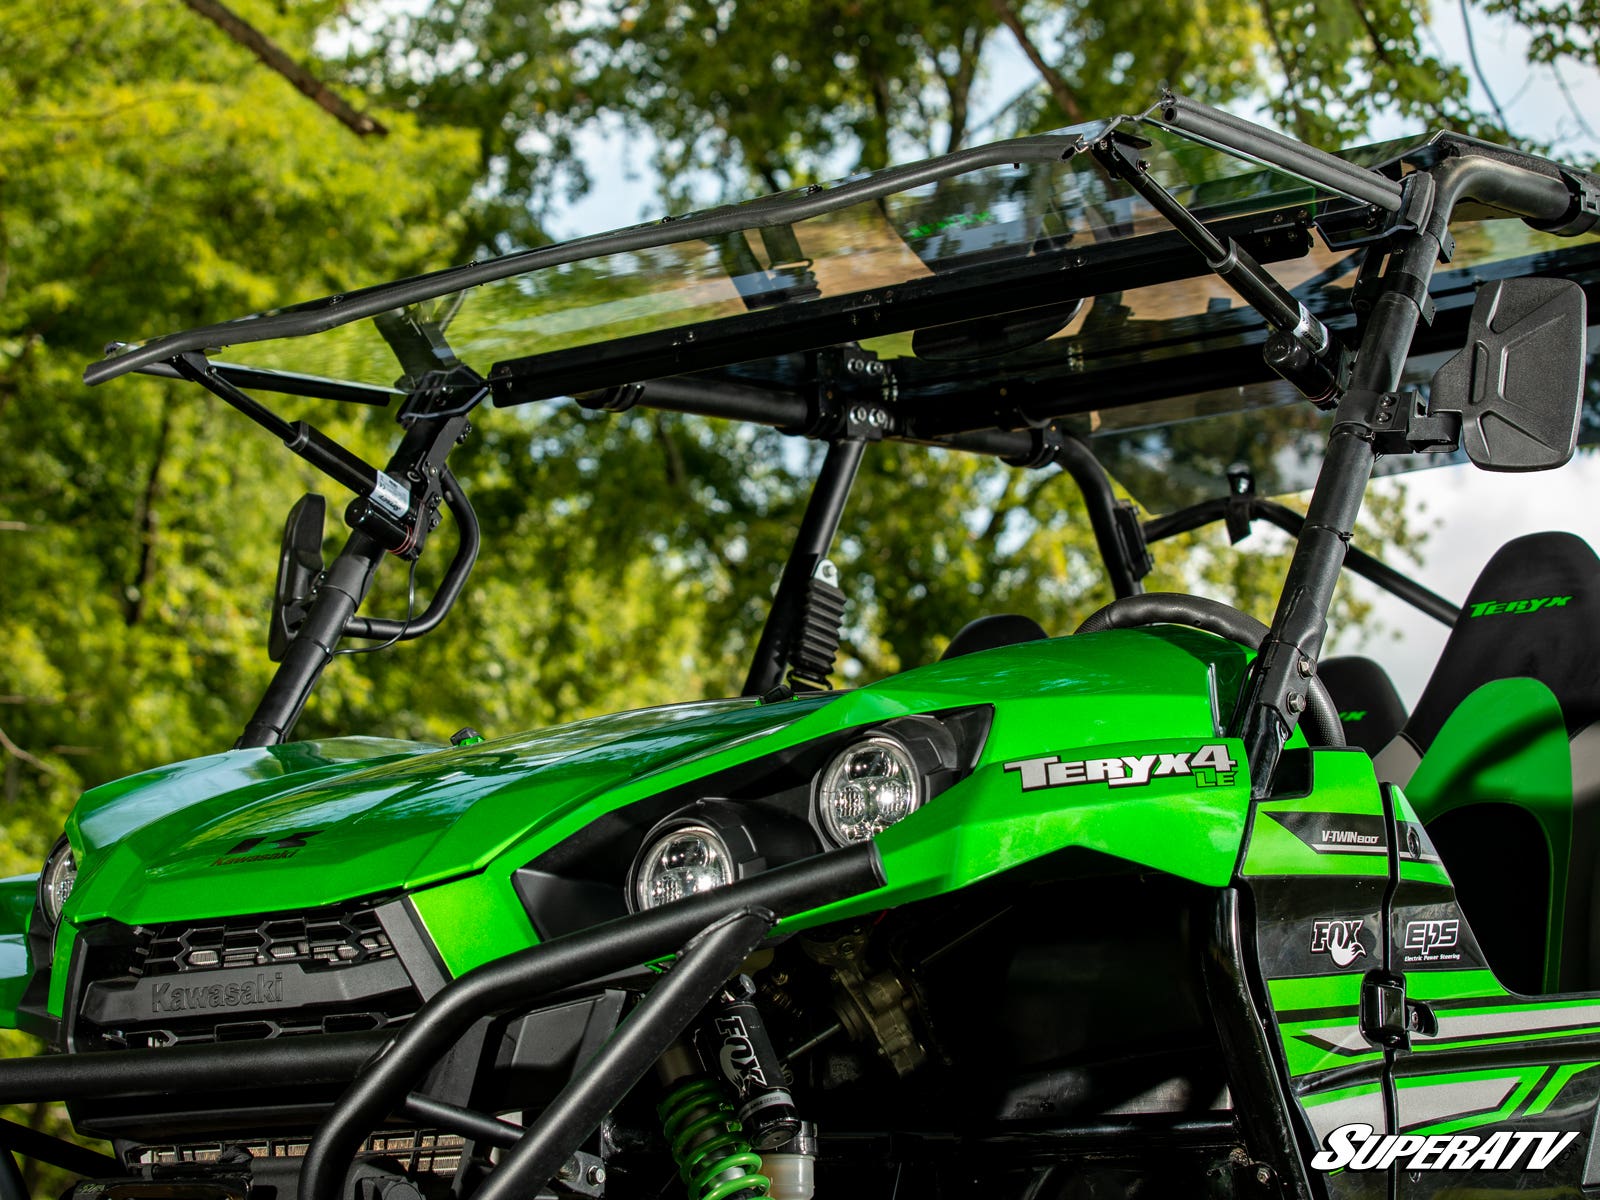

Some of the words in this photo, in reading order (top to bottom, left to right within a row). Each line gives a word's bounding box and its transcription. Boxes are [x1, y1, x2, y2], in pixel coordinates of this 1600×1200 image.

[1196, 770, 1238, 788] LE
[1310, 919, 1366, 960] FOX
[1404, 919, 1460, 955] EPS
[151, 971, 284, 1013] Kawasaki
[714, 1015, 768, 1088] FOX
